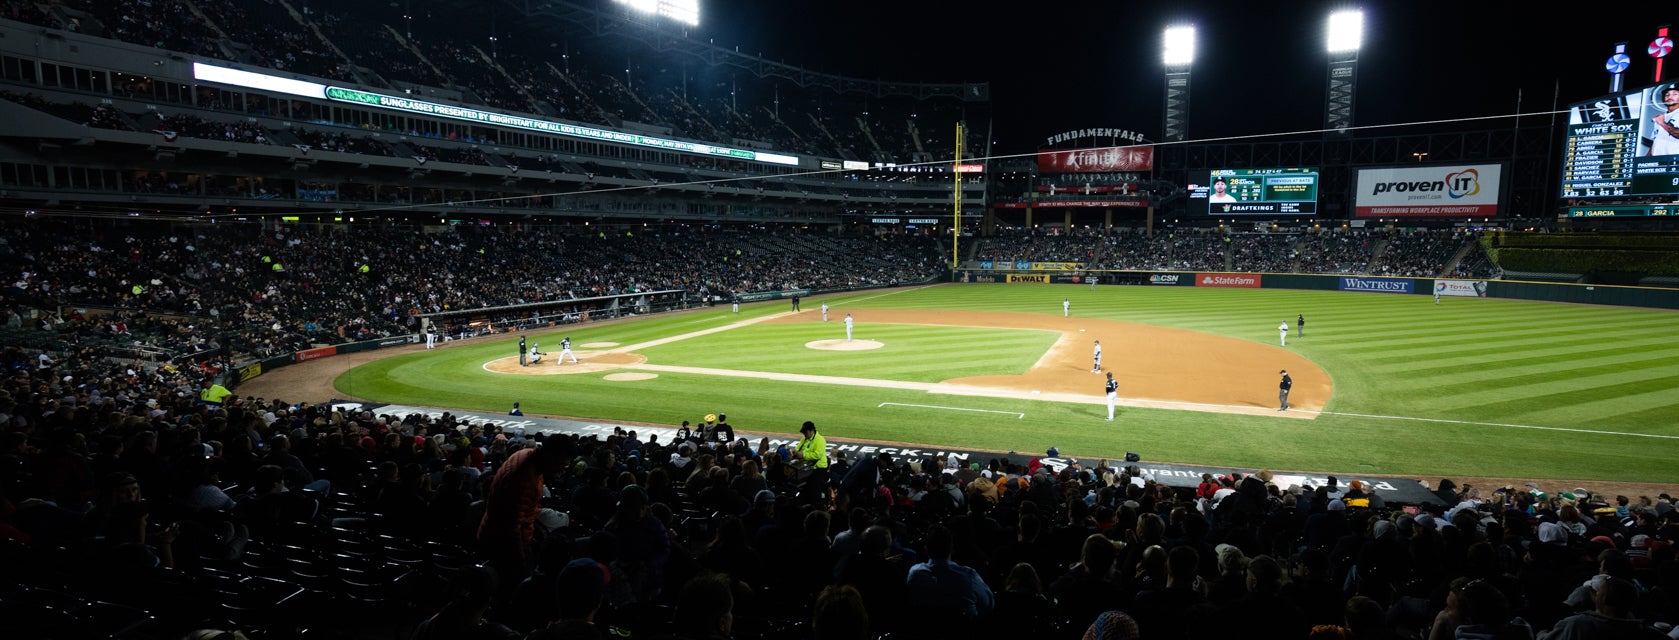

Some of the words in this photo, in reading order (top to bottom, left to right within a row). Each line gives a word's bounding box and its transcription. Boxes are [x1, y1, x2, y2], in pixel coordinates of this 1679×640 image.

[380, 97, 433, 112] SUNGLASSES
[434, 106, 477, 119] PRESENTED
[489, 115, 532, 128] BRIGHTSTART
[549, 123, 560, 131] ALL
[561, 125, 574, 133] KIDS
[582, 128, 600, 137] YEARS
[601, 131, 613, 139] AND
[1047, 128, 1144, 145] FUNDAMENTALS
[1575, 126, 1608, 135] WHITE
[1611, 124, 1633, 132] SOX
[1372, 181, 1444, 195] proven
[1454, 178, 1472, 190] IT
[1345, 278, 1408, 290] WINTRUST
